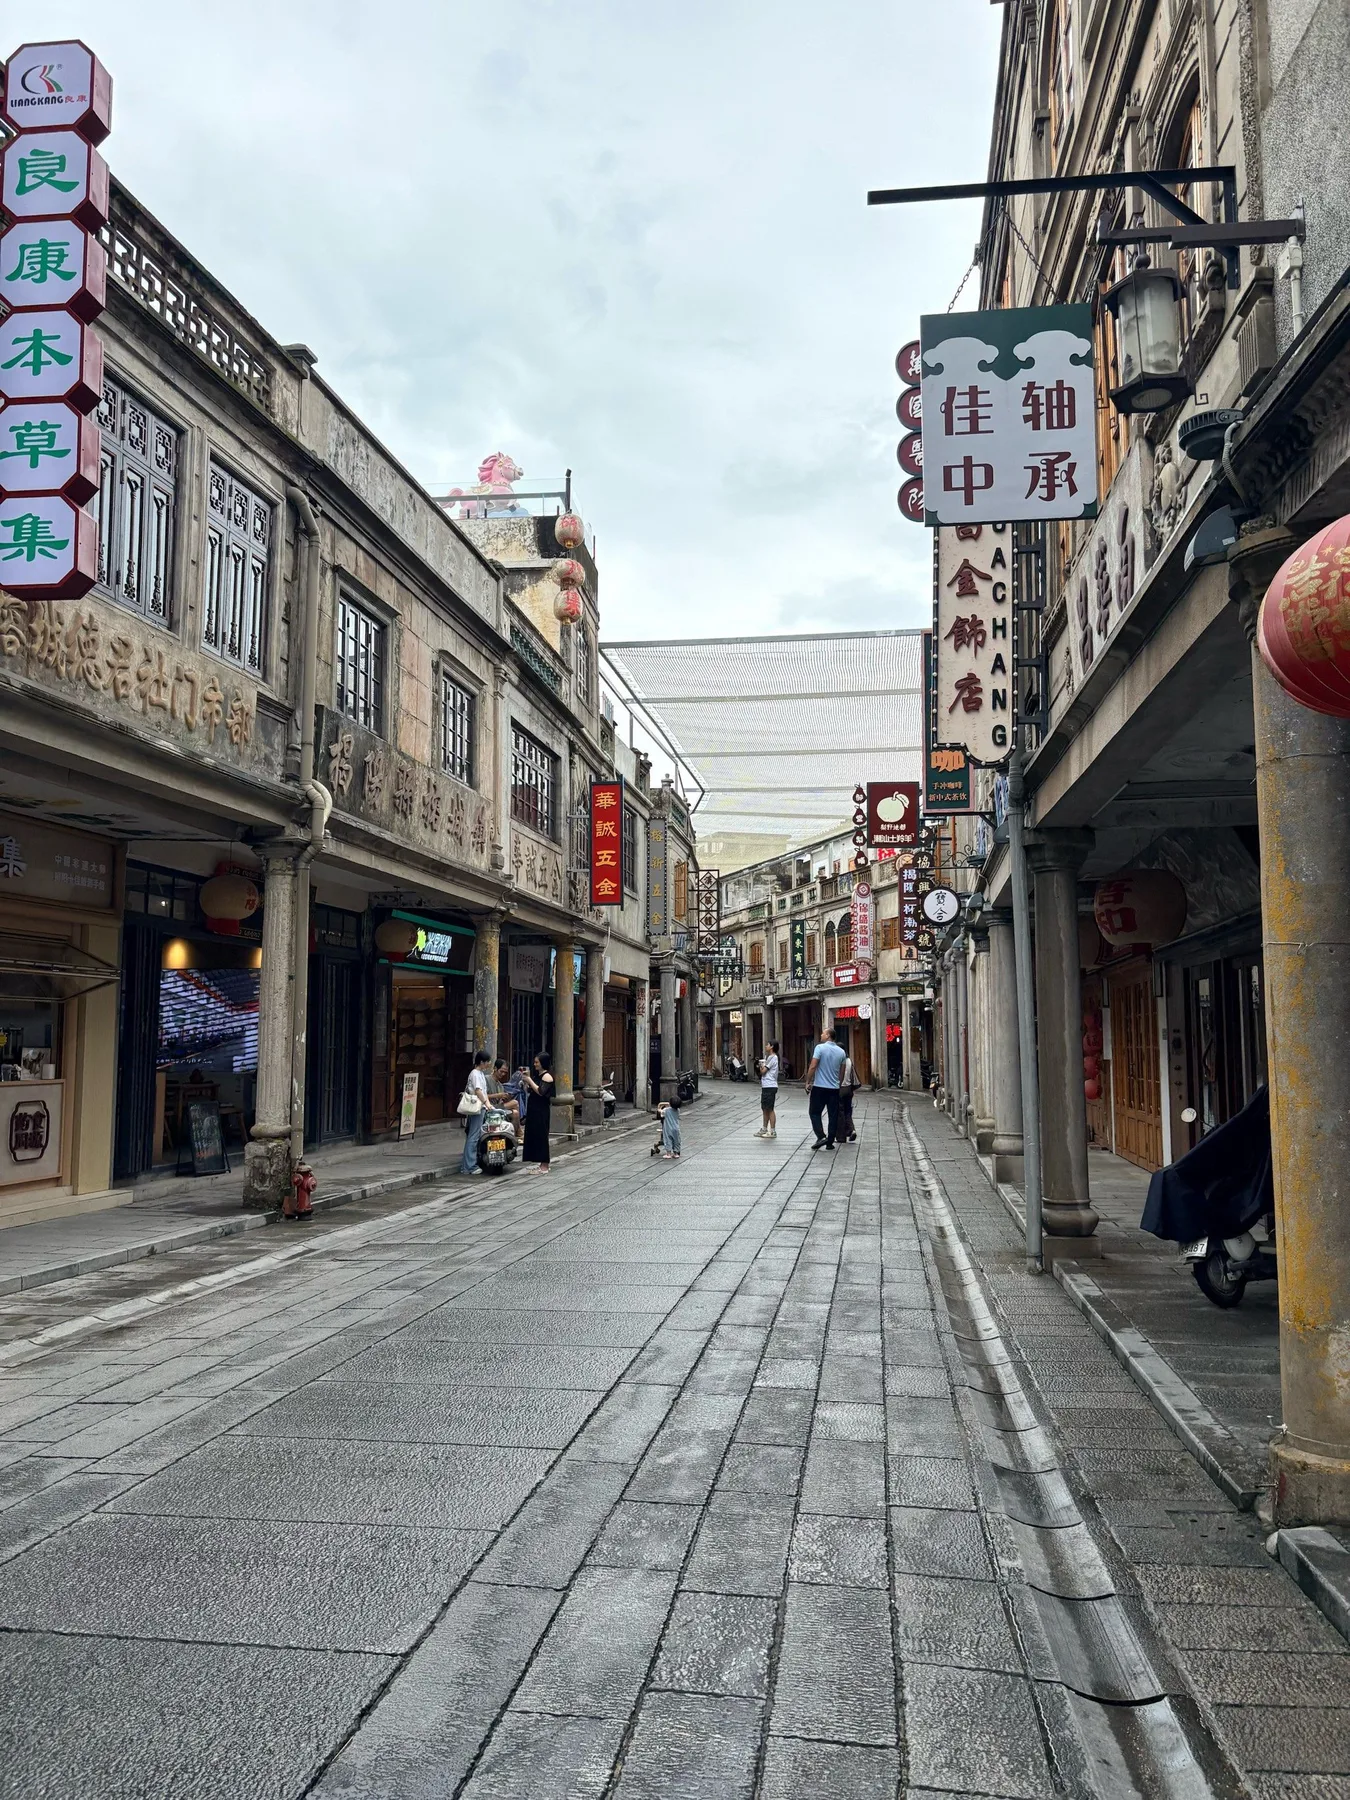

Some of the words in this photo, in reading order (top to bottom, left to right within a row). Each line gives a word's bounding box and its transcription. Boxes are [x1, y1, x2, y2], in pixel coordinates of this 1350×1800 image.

[10, 96, 64, 108] LIANGKANG
[0, 148, 80, 564] 良康本草集
[595, 791, 618, 896] 華誠五金
